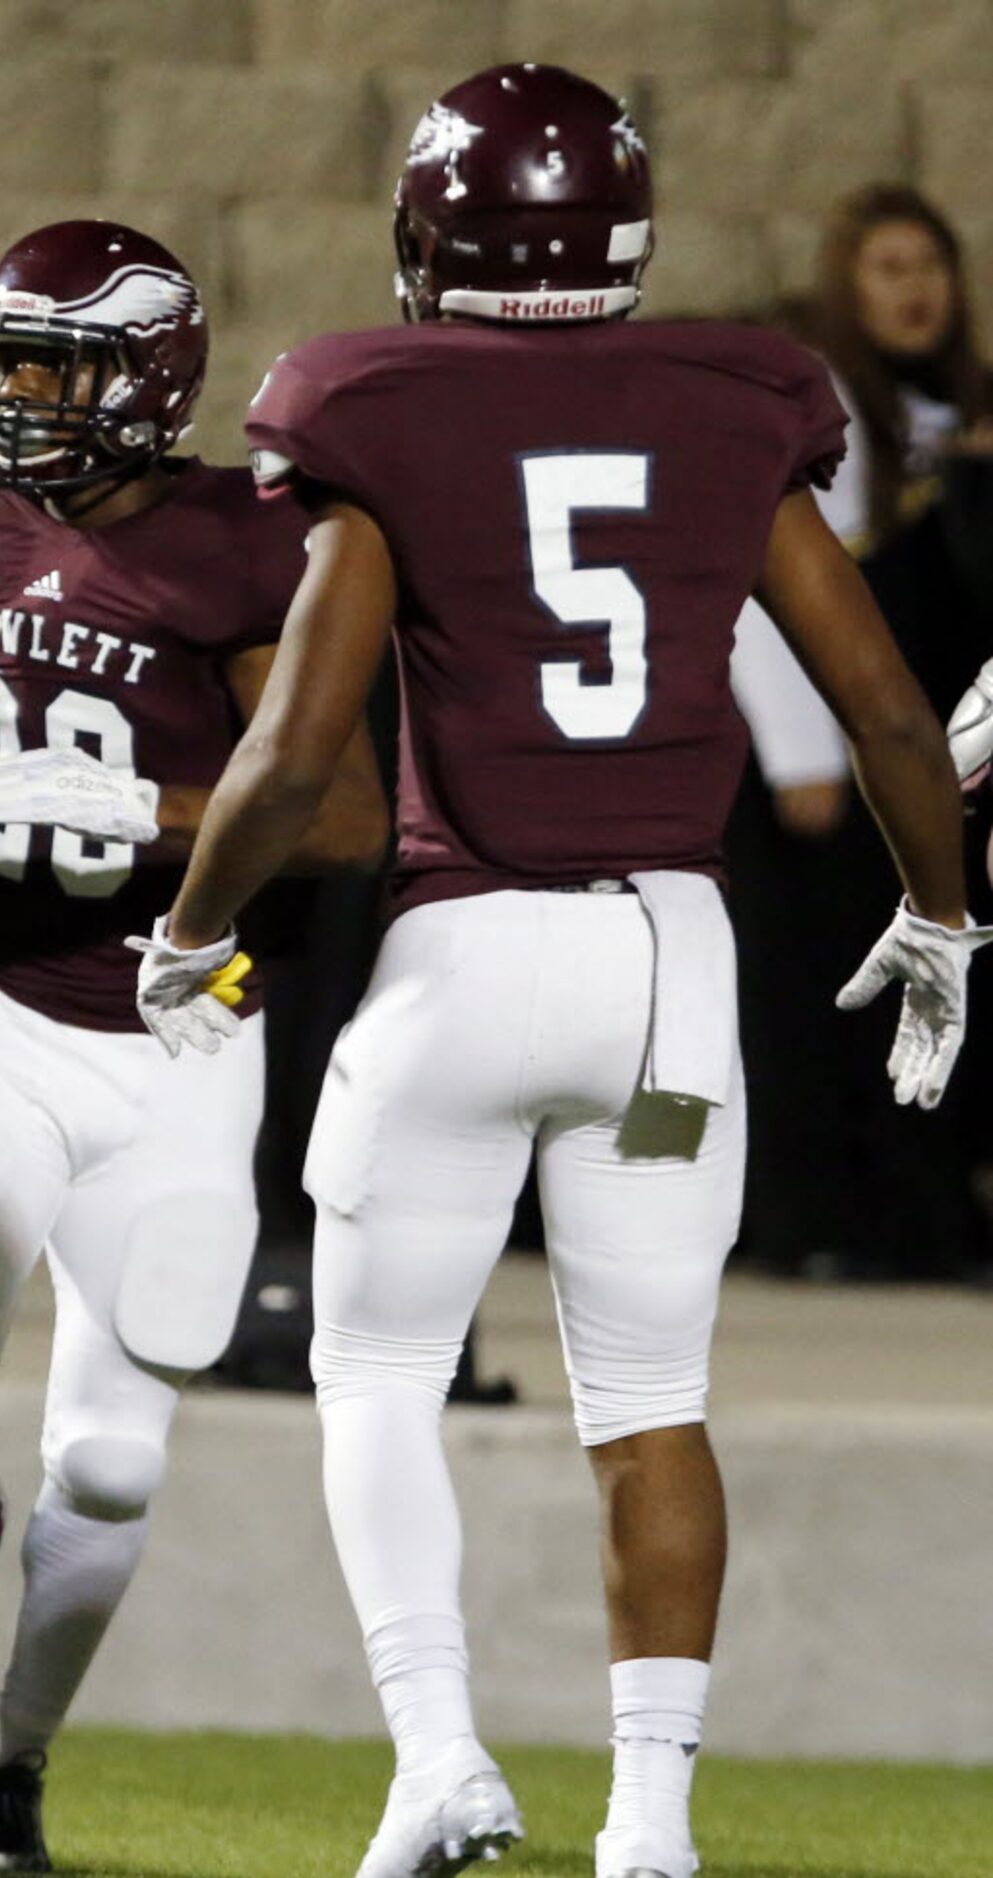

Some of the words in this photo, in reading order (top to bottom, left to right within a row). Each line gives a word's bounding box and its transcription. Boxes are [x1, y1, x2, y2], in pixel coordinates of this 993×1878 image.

[547, 150, 564, 177] 5
[500, 296, 605, 317] Riddell
[521, 454, 648, 739] 5
